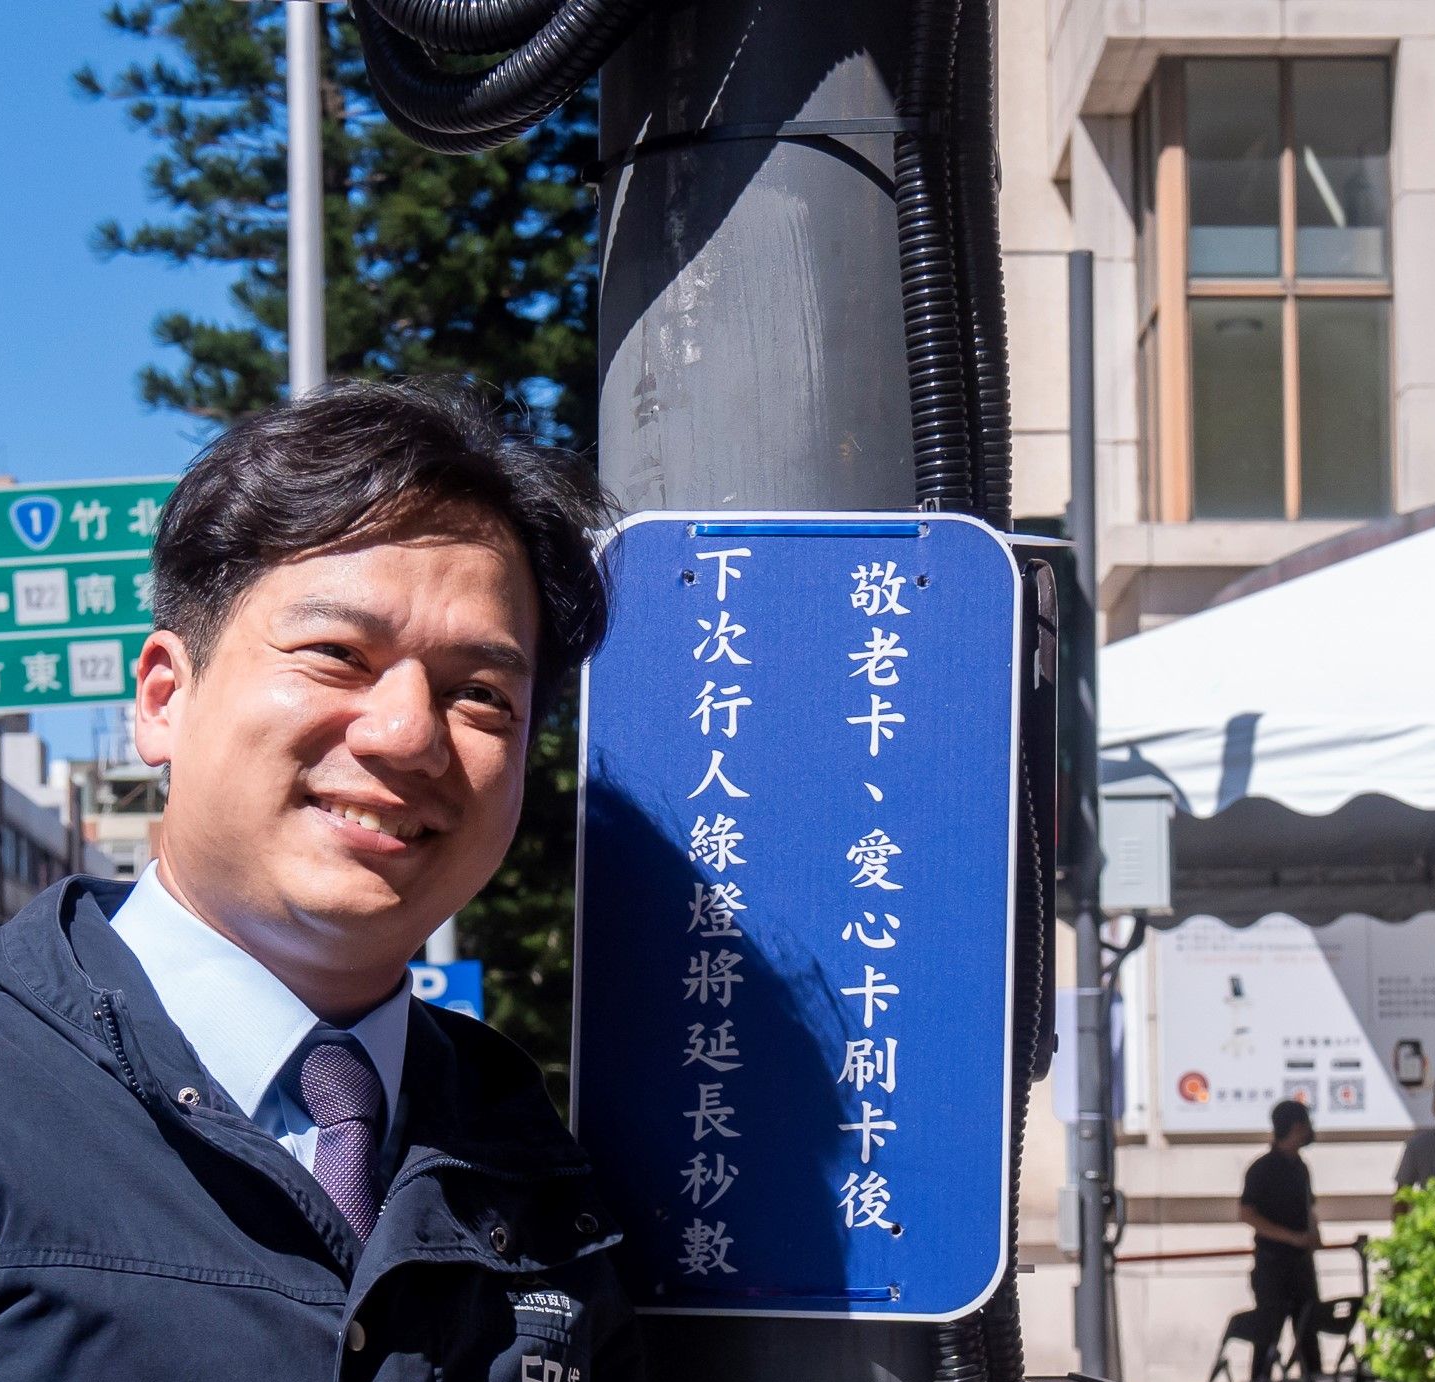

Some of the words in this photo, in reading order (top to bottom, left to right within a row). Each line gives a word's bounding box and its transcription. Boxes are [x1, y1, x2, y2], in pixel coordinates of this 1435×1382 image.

[80, 654, 116, 680] 122
[678, 546, 754, 1276] 下次行人綠燈將延長秒數
[837, 560, 911, 1230] 敬老卡、愛心卡刷卡後
